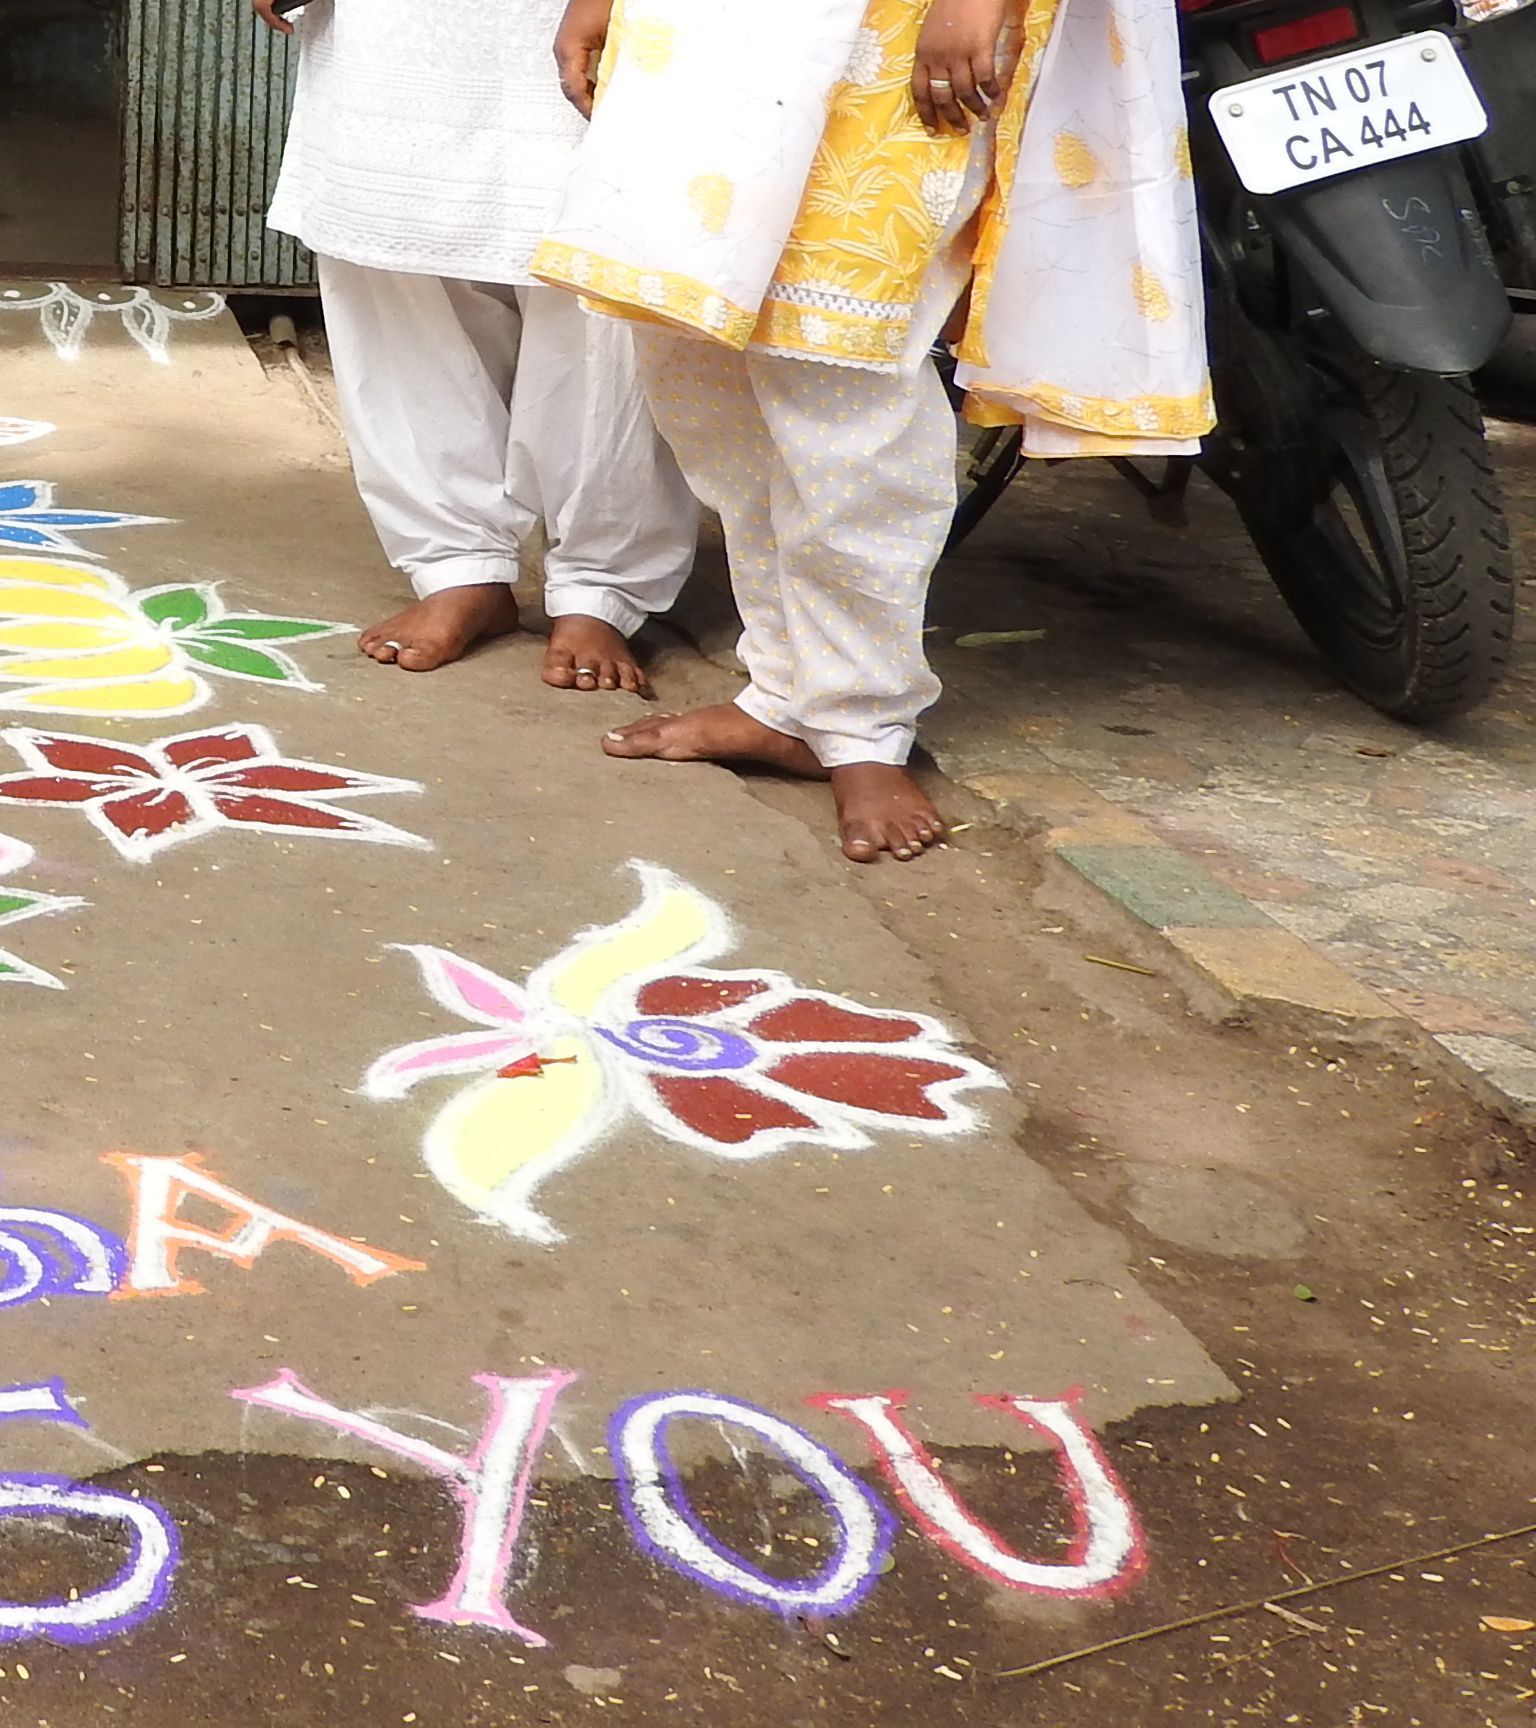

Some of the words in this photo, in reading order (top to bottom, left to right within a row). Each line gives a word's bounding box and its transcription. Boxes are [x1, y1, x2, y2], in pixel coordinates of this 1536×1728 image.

[1272, 75, 1337, 121] TN
[1344, 60, 1388, 103] 07
[1285, 127, 1354, 171] CA
[1361, 101, 1431, 148] 444
[232, 1368, 1147, 1650] YOU
